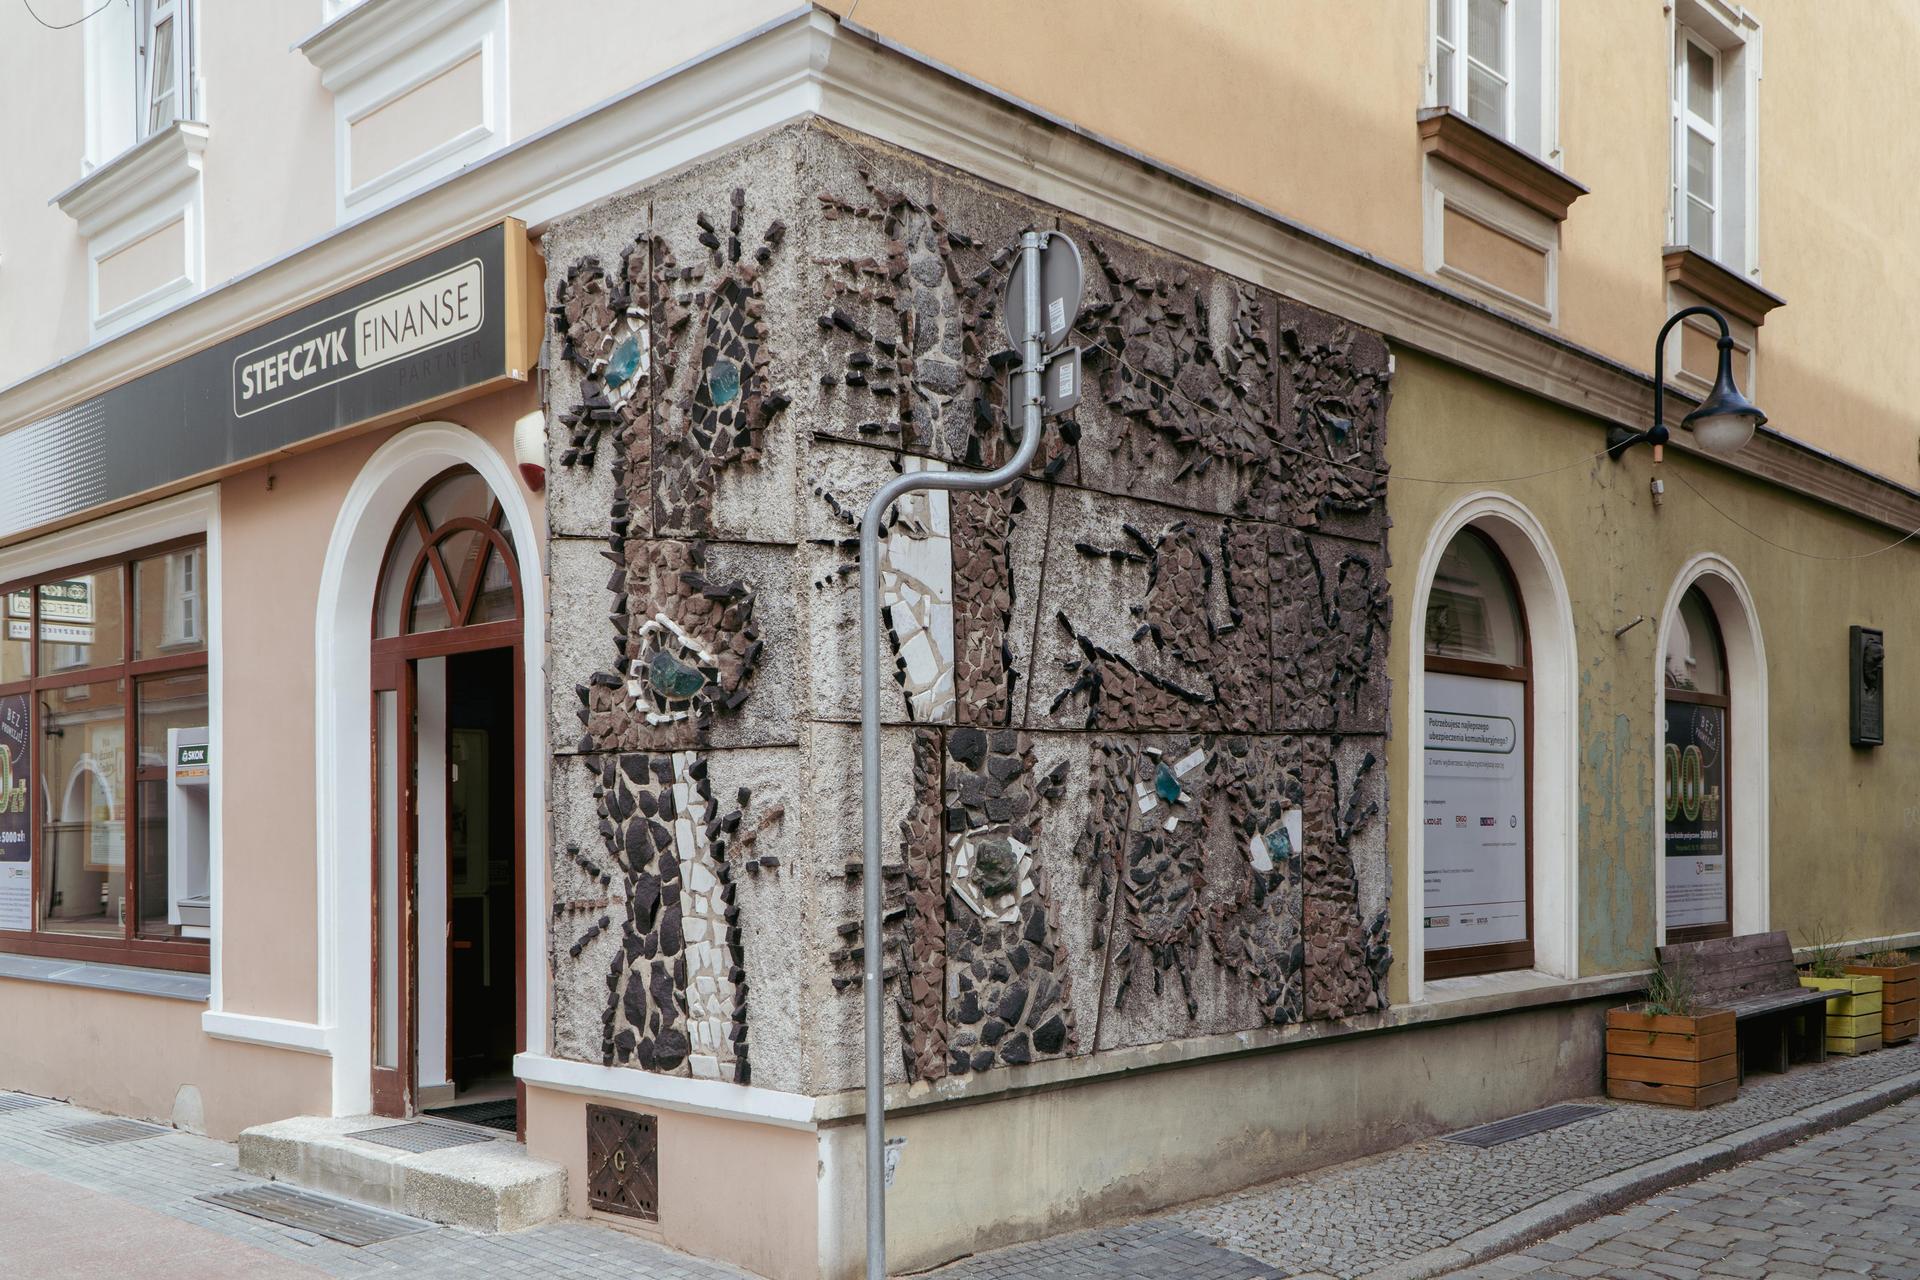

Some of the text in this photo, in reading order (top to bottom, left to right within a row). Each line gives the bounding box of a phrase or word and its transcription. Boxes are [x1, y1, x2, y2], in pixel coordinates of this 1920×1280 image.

[242, 282, 470, 400] STEFCZYK FINANSE
[399, 340, 483, 385] PARTNER
[7, 707, 20, 728] BEZ
[1429, 717, 1489, 732] Potrzebujesz najlepszego
[1701, 715, 1714, 735] BEZ
[1429, 731, 1508, 746] ubezpieczenia komunikacyjnego?
[188, 750, 204, 761] SKOK
[1, 831, 17, 843] 5000
[1700, 830, 1712, 839] 5000
[614, 1149, 627, 1172] G
